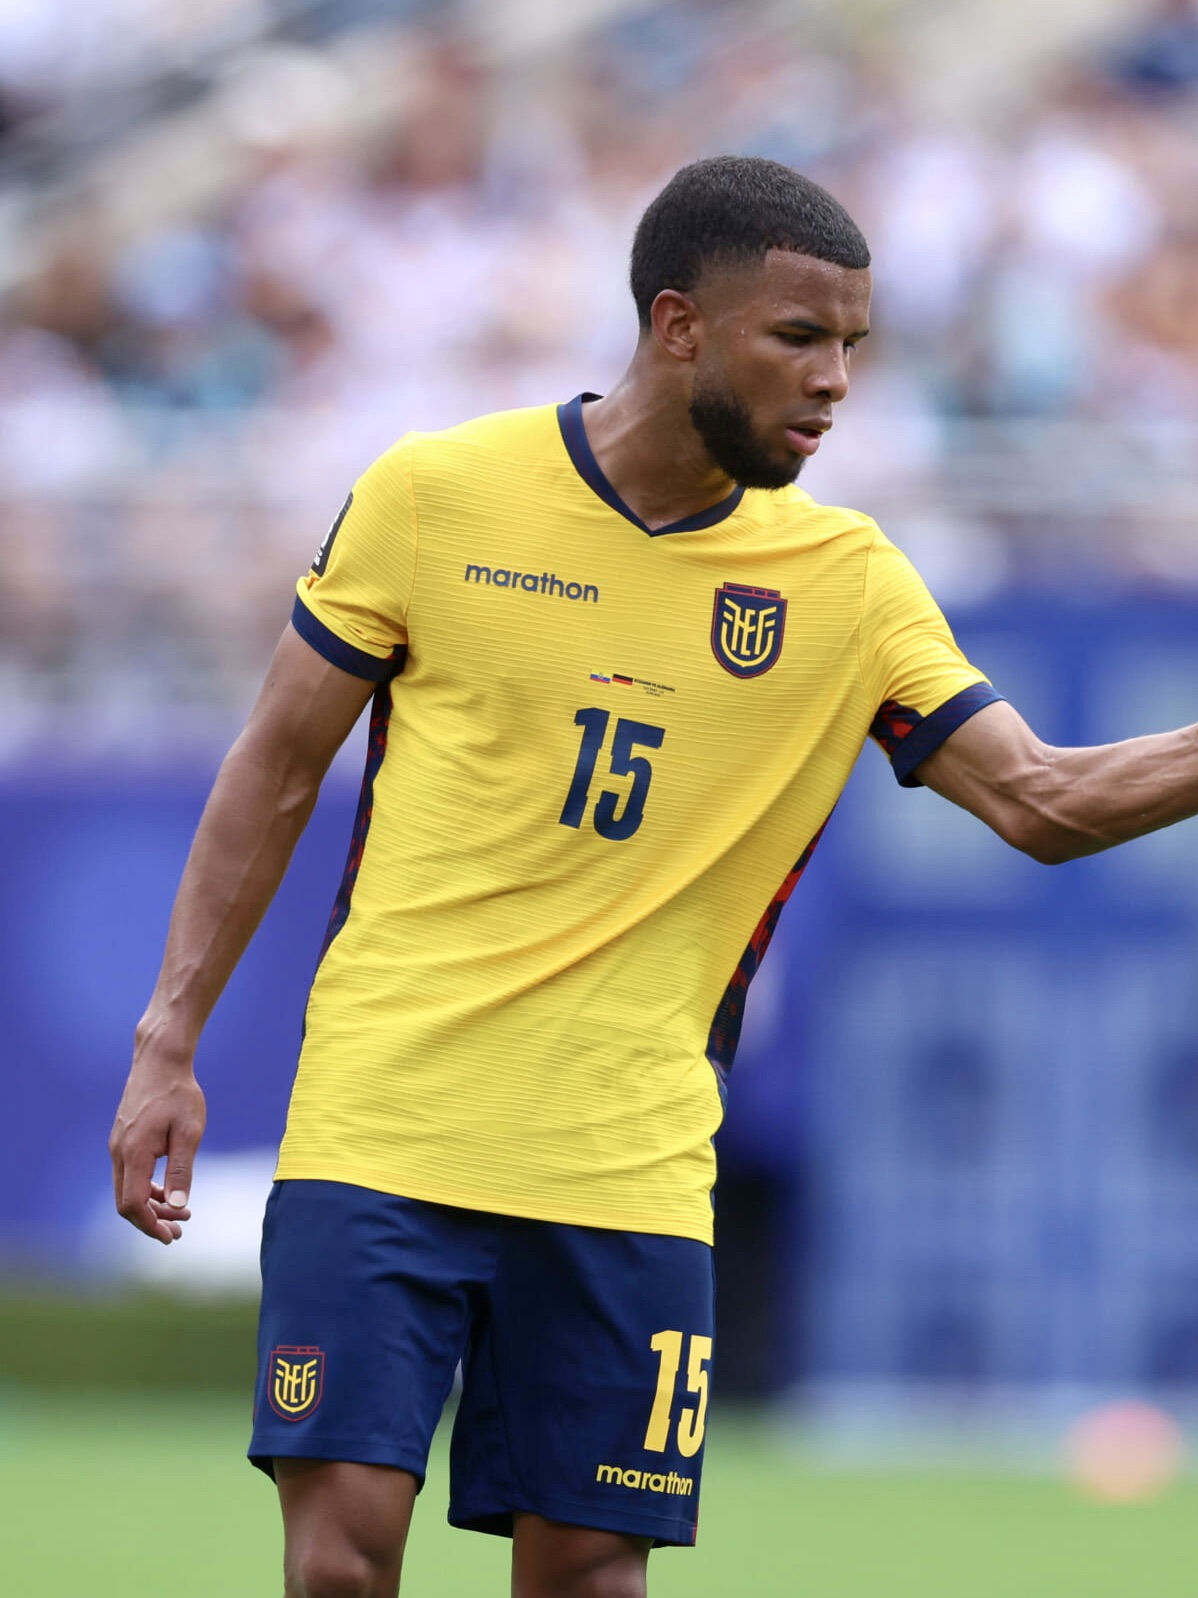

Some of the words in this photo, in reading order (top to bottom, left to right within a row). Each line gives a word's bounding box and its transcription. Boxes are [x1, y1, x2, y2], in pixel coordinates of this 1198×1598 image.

[465, 564, 599, 603] marathon
[559, 707, 666, 841] 15
[643, 1330, 712, 1458] 15
[596, 1464, 693, 1496] marathon
